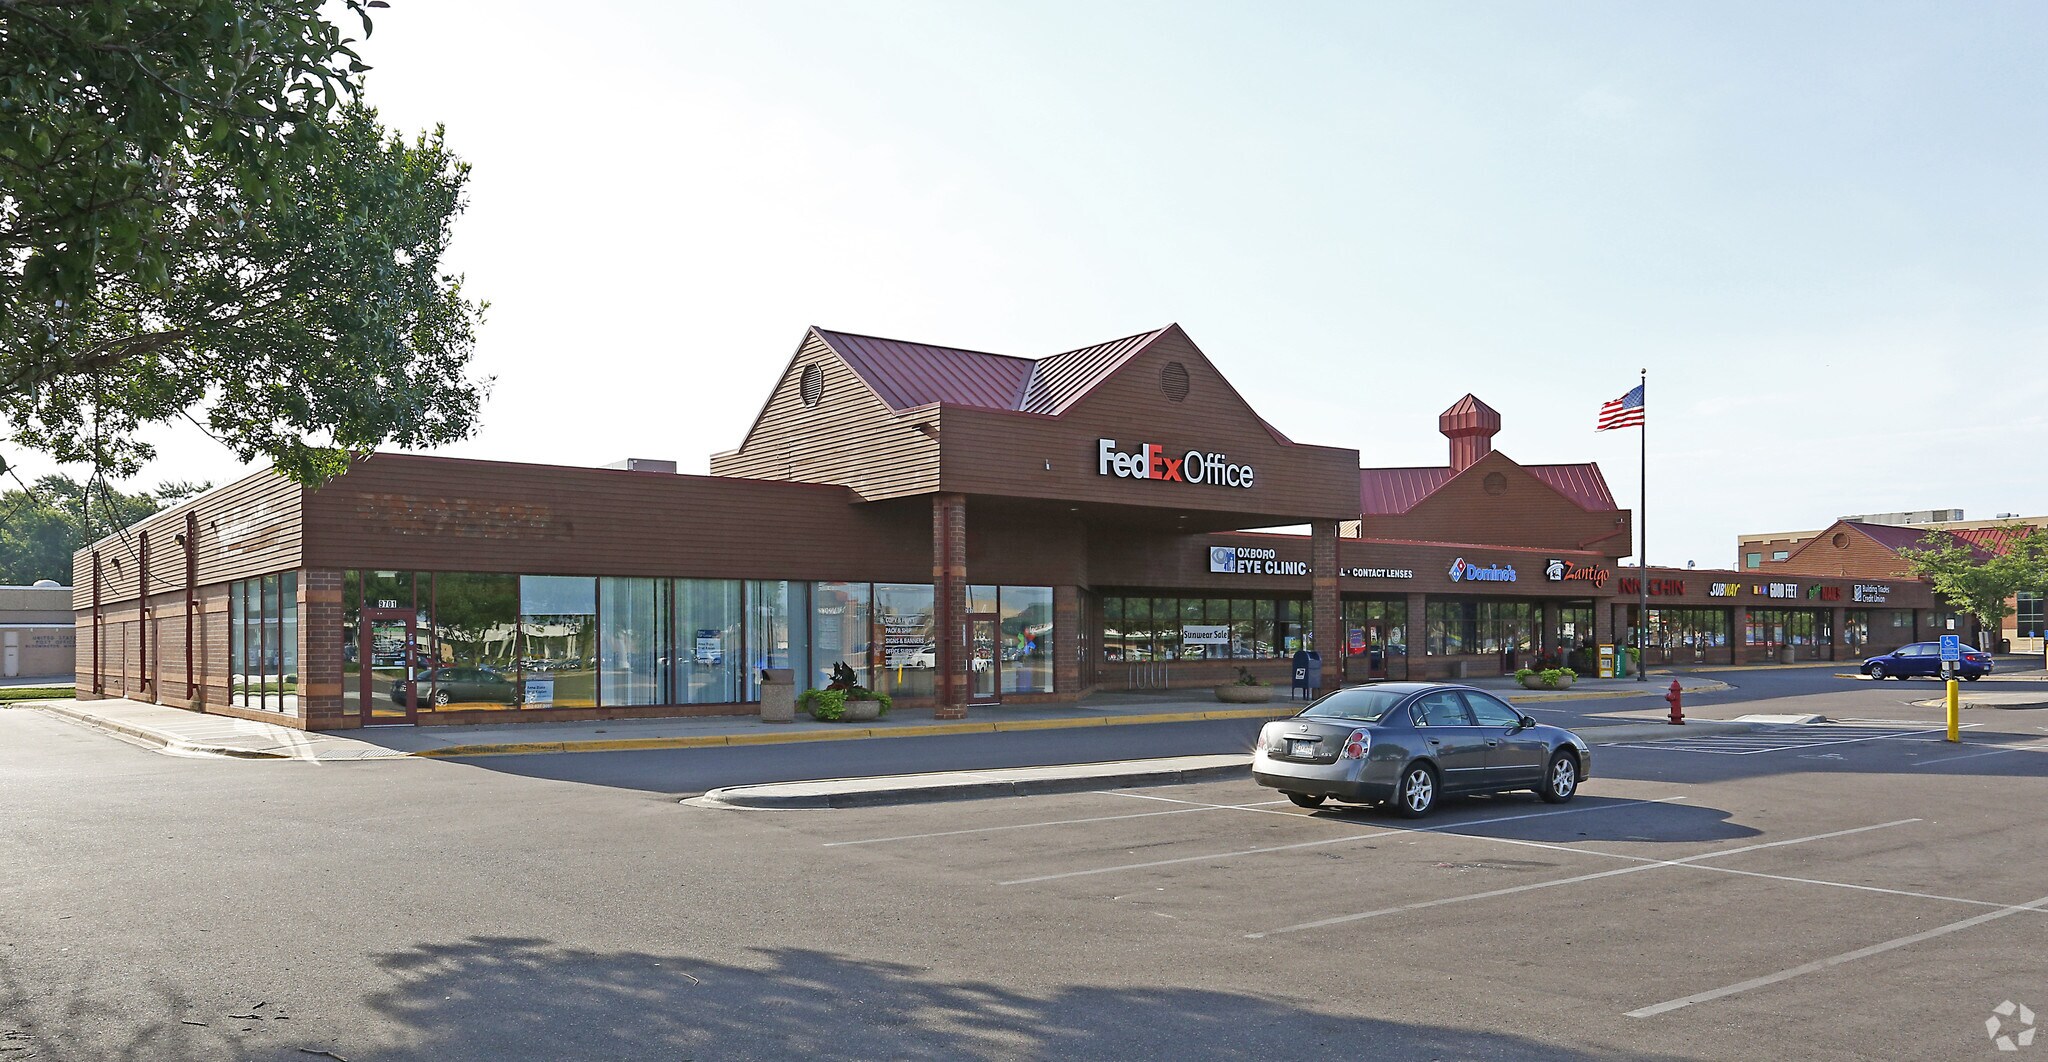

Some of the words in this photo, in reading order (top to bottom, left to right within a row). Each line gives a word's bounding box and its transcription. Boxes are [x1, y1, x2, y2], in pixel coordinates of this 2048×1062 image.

[1098, 438, 1183, 482] FedEx
[1183, 450, 1254, 488] Office
[1237, 547, 1276, 559] OXBORO
[1237, 560, 1261, 574] EYE
[1264, 561, 1307, 576] CLINIC
[1352, 568, 1385, 578] CONTACT
[1386, 569, 1413, 579] LENSES
[1466, 563, 1517, 582] Domino's
[1563, 560, 1610, 588] Zantigo
[1650, 579, 1686, 596] CHIN
[1710, 583, 1740, 597] SUBWAY
[1769, 583, 1784, 598] GOOD
[1785, 583, 1798, 598] FEET
[1862, 584, 1877, 594] Building
[379, 600, 396, 608] 9701
[1862, 594, 1873, 603] Credit
[1873, 595, 1886, 603] Union
[1184, 630, 1213, 639] Sunwear
[1213, 630, 1227, 639] Sale
